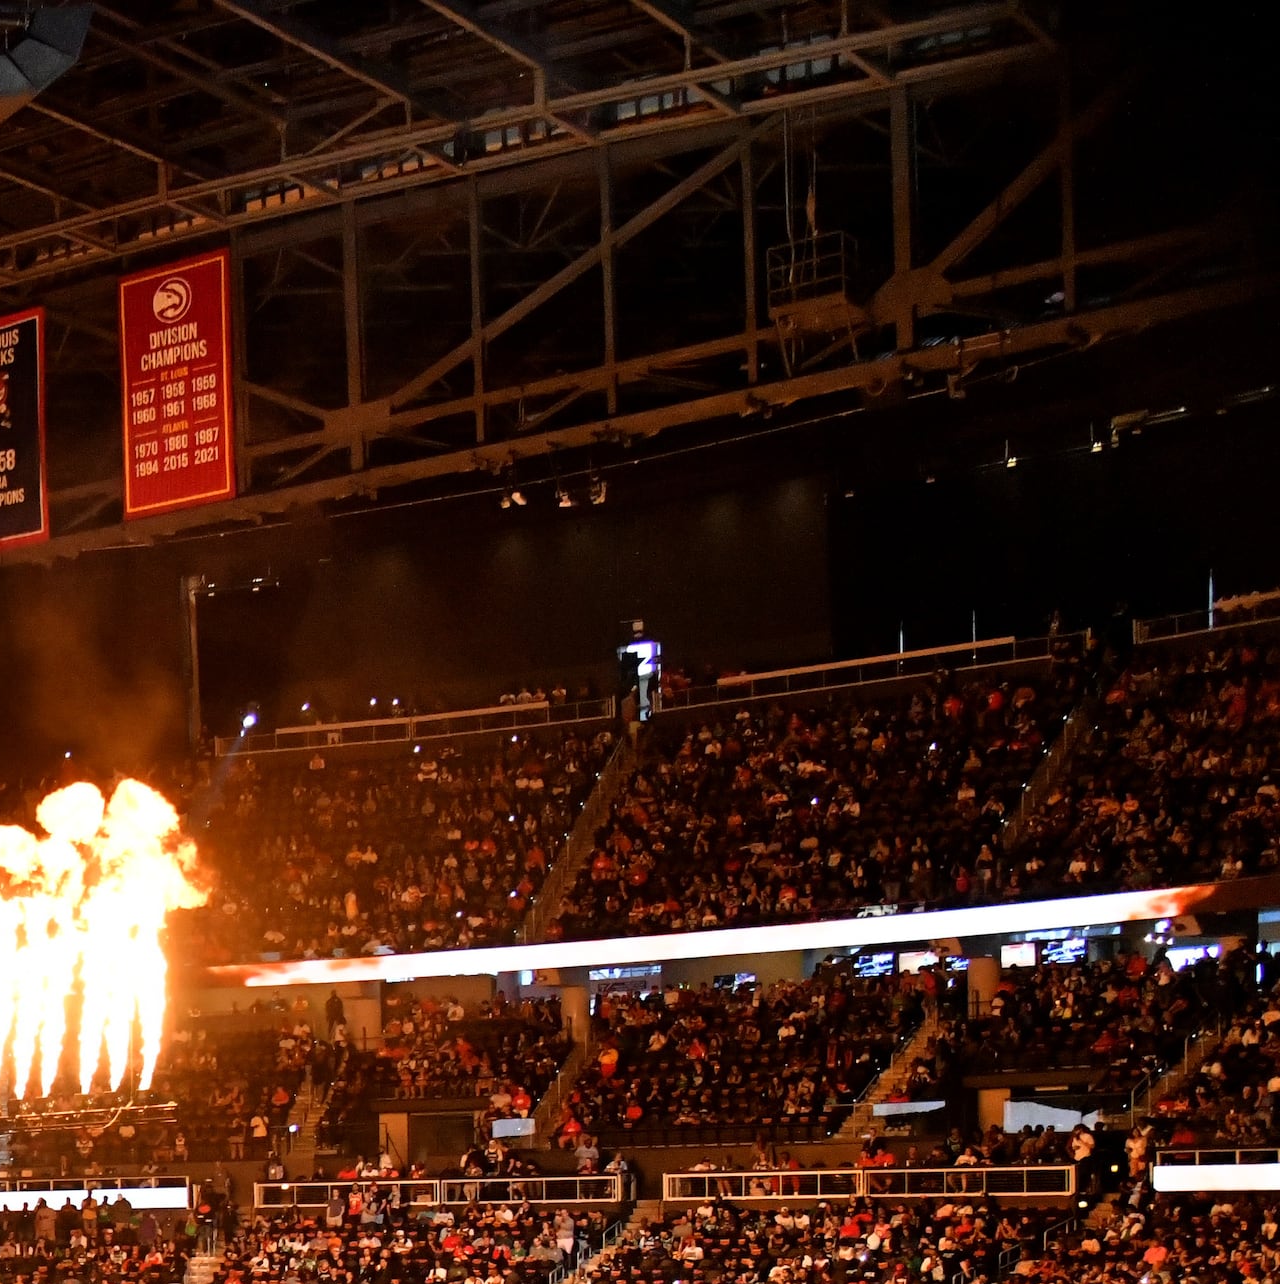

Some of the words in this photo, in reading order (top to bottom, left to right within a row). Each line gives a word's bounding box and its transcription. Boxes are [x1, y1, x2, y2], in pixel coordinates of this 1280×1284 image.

[149, 321, 197, 350] DIVISION
[141, 339, 208, 372] CHAMPIONS
[132, 388, 156, 408] 1957
[161, 380, 185, 400] 1958
[191, 373, 216, 393] 1959
[133, 406, 156, 426] 1960
[163, 399, 185, 419] 1961
[192, 392, 217, 412] 1968
[135, 440, 158, 460] 1970
[164, 433, 189, 453] 1980
[195, 426, 219, 446] 1987
[135, 459, 159, 478] 1994
[163, 452, 189, 472] 2015
[194, 445, 219, 465] 2021
